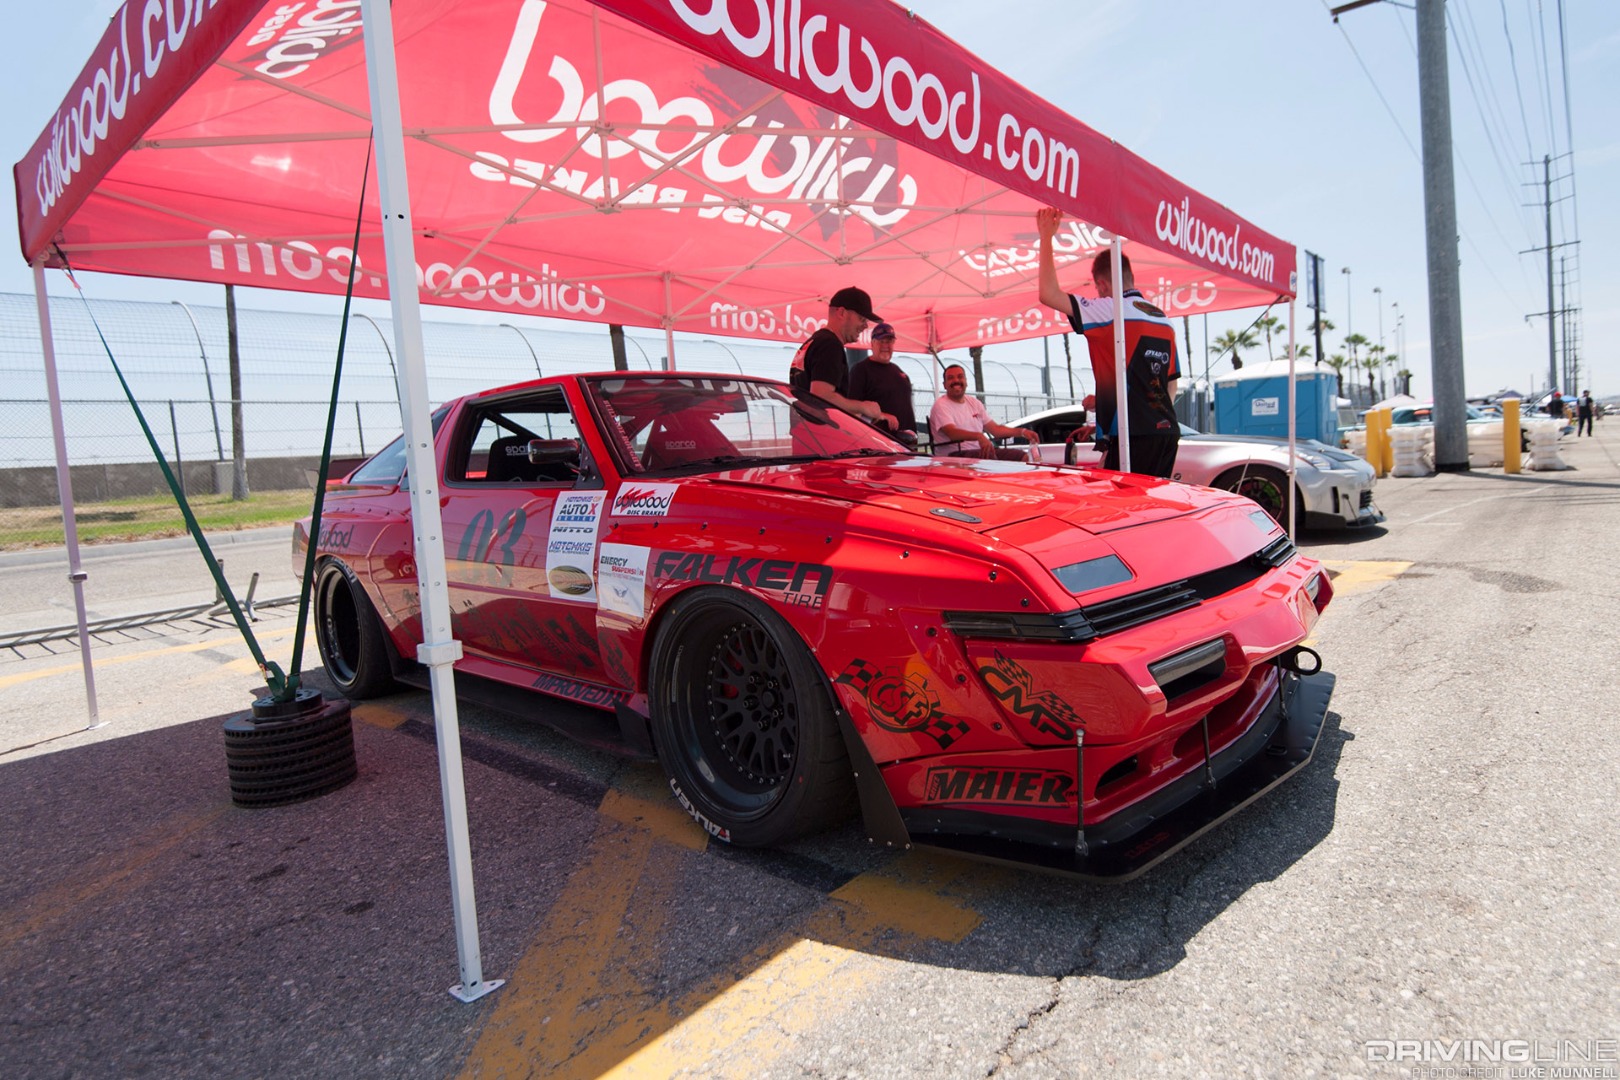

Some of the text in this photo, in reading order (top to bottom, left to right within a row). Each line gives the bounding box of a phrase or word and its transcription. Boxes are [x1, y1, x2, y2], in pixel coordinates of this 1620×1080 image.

[1154, 196, 1275, 283] wilwood.com
[665, 440, 696, 448] sparco
[560, 503, 599, 515] AUTO X
[549, 541, 593, 552] HOTCHKIS
[600, 555, 628, 567] ENERGY
[654, 551, 833, 595] FALKEN
[782, 592, 823, 609] TIRE
[928, 771, 1073, 803] MAIER
